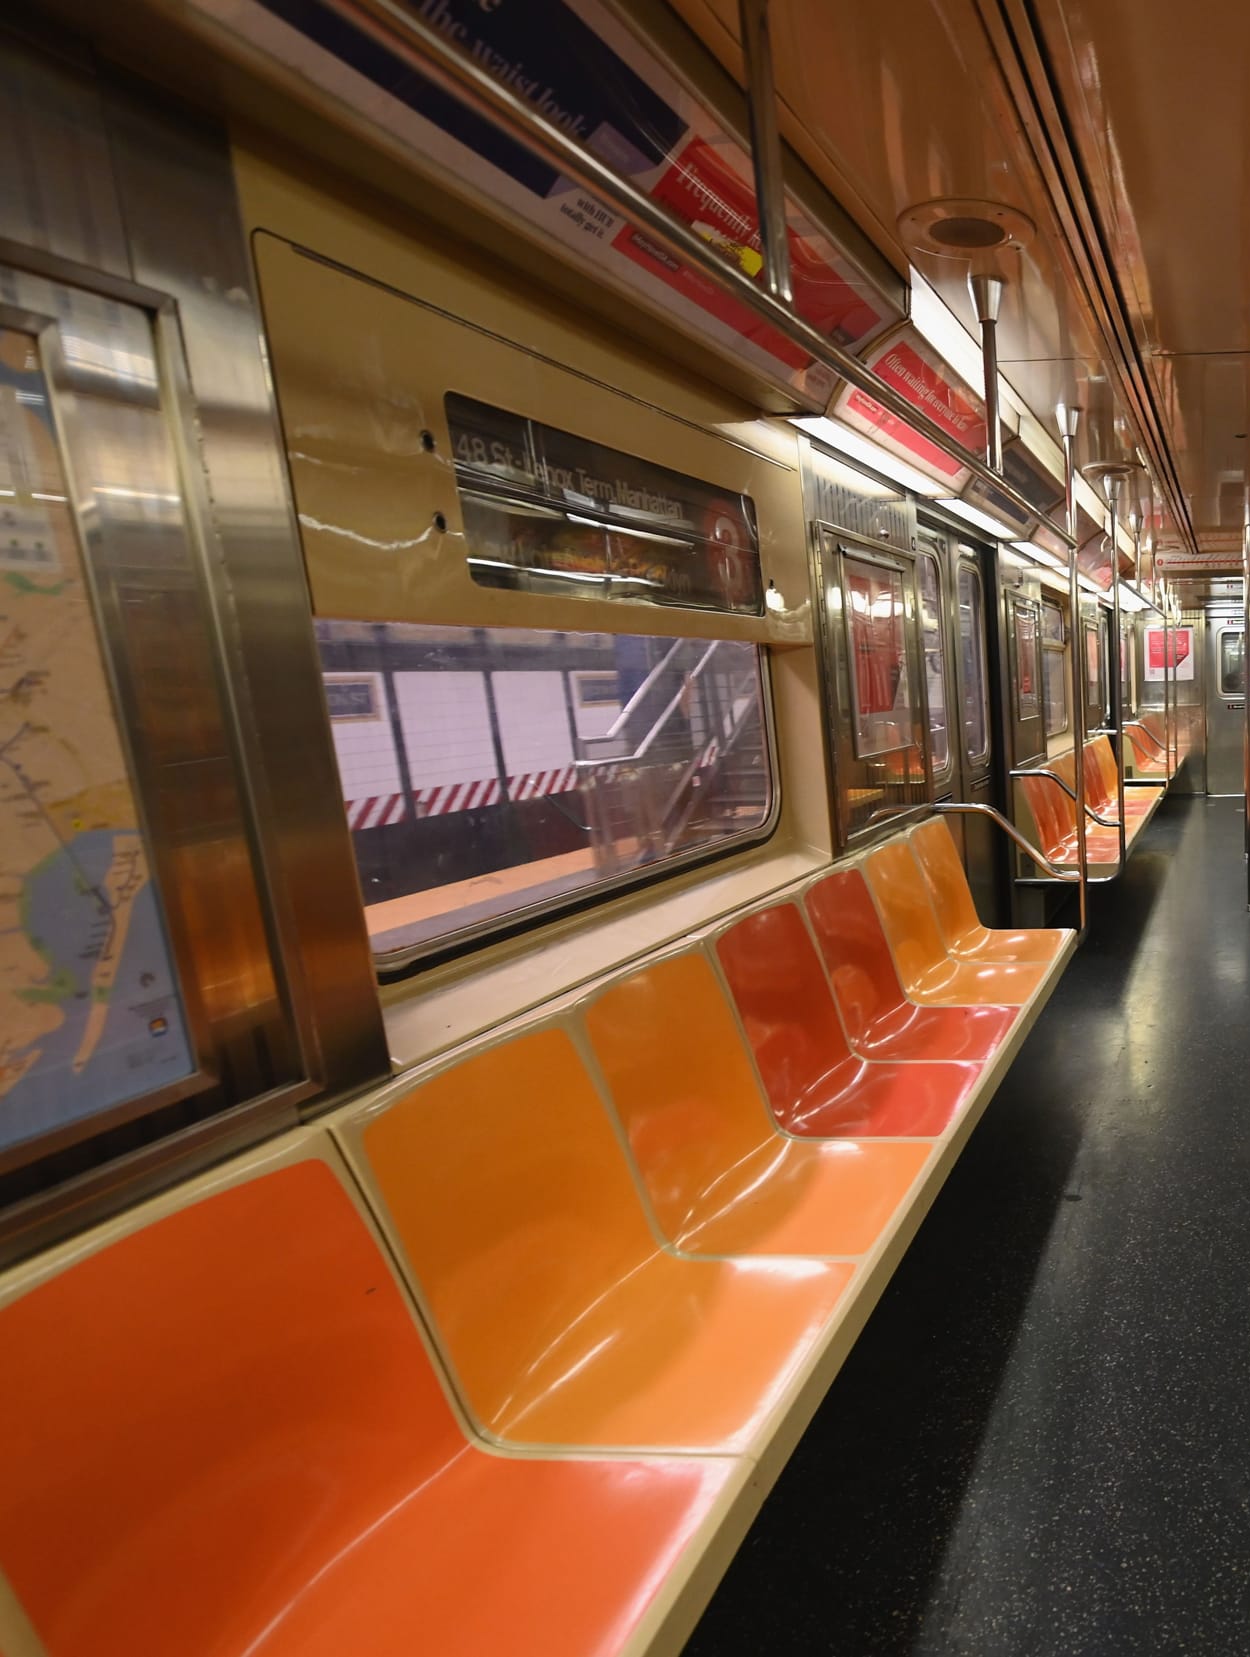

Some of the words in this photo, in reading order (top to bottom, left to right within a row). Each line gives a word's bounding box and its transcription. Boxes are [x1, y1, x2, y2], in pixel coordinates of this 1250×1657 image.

[885, 354, 906, 378] Often
[615, 480, 684, 519] Manhattan
[715, 516, 740, 591] 3
